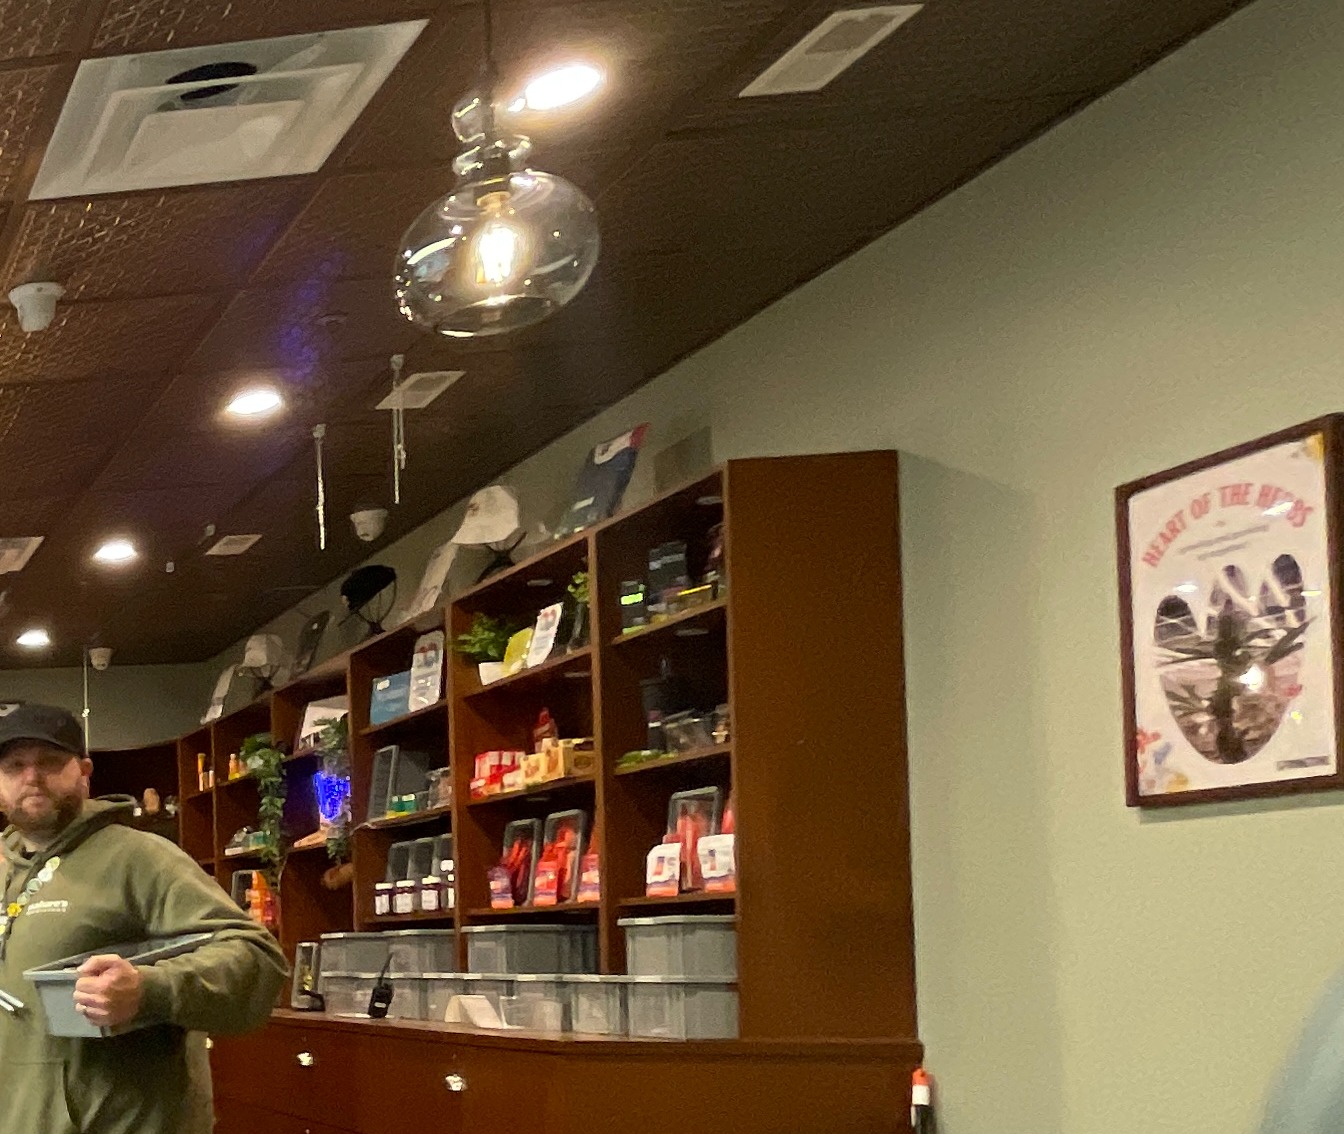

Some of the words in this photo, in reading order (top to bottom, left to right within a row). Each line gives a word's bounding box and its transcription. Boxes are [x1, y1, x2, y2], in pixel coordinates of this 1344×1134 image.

[1142, 509, 1187, 568] HEART
[1189, 492, 1213, 520] OF
[1218, 482, 1255, 508] THE
